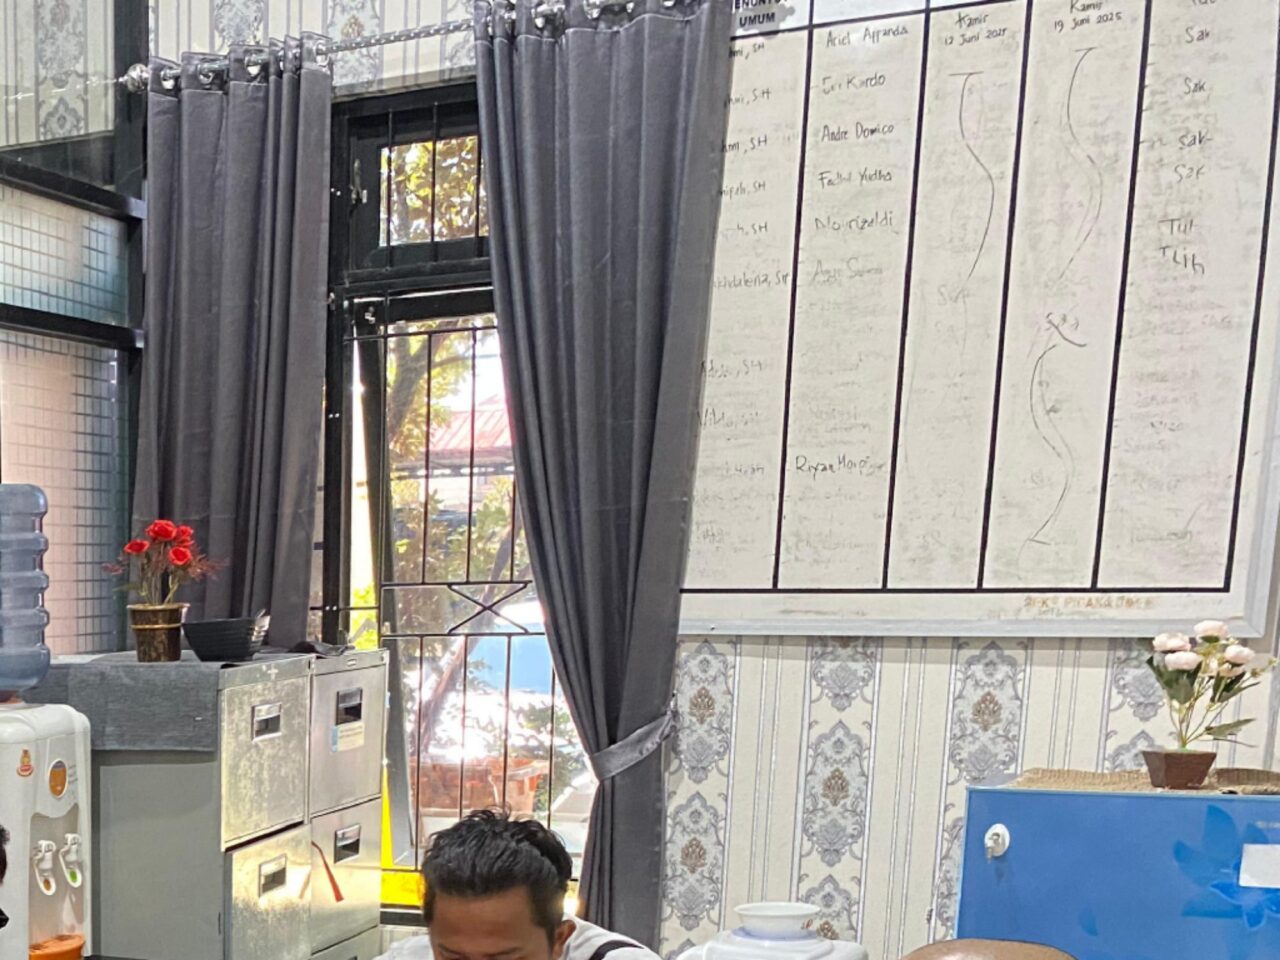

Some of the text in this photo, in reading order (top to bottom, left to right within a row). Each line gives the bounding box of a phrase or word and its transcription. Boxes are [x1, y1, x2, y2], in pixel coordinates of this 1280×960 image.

[739, 12, 776, 28] UMUM
[1054, 12, 1122, 32] 19 Juni 2025
[826, 30, 851, 47] Ariel
[752, 88, 771, 102] SH
[750, 134, 767, 150] SH
[753, 181, 766, 192] SH
